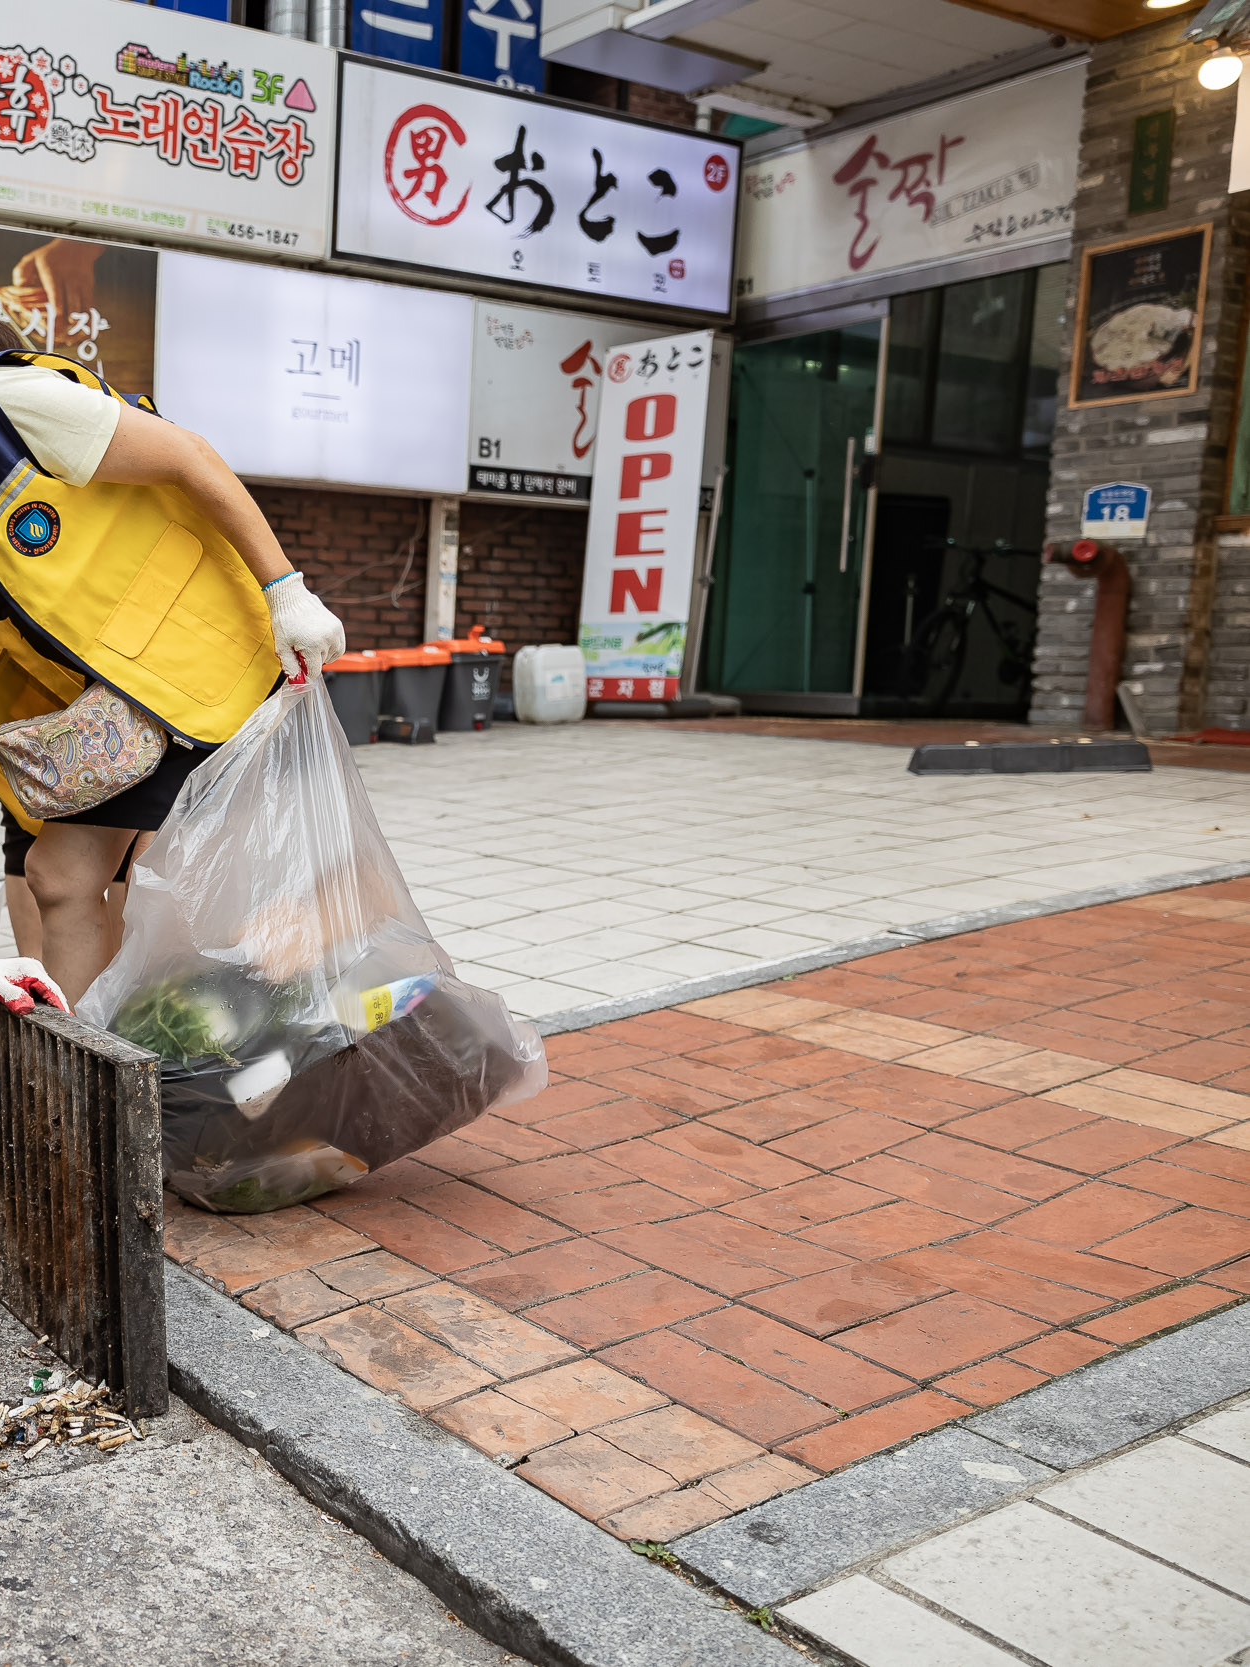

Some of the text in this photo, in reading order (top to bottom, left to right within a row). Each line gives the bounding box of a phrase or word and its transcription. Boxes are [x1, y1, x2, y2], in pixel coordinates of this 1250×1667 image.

[90, 88, 314, 188] 노래연습장
[400, 124, 681, 257] 男 おとこ
[228, 222, 300, 248] 456-1847
[285, 337, 361, 388] 고메
[636, 344, 705, 379] おとこ
[477, 436, 502, 460] B1
[608, 393, 679, 615] OPEN
[1101, 504, 1131, 522] 18
